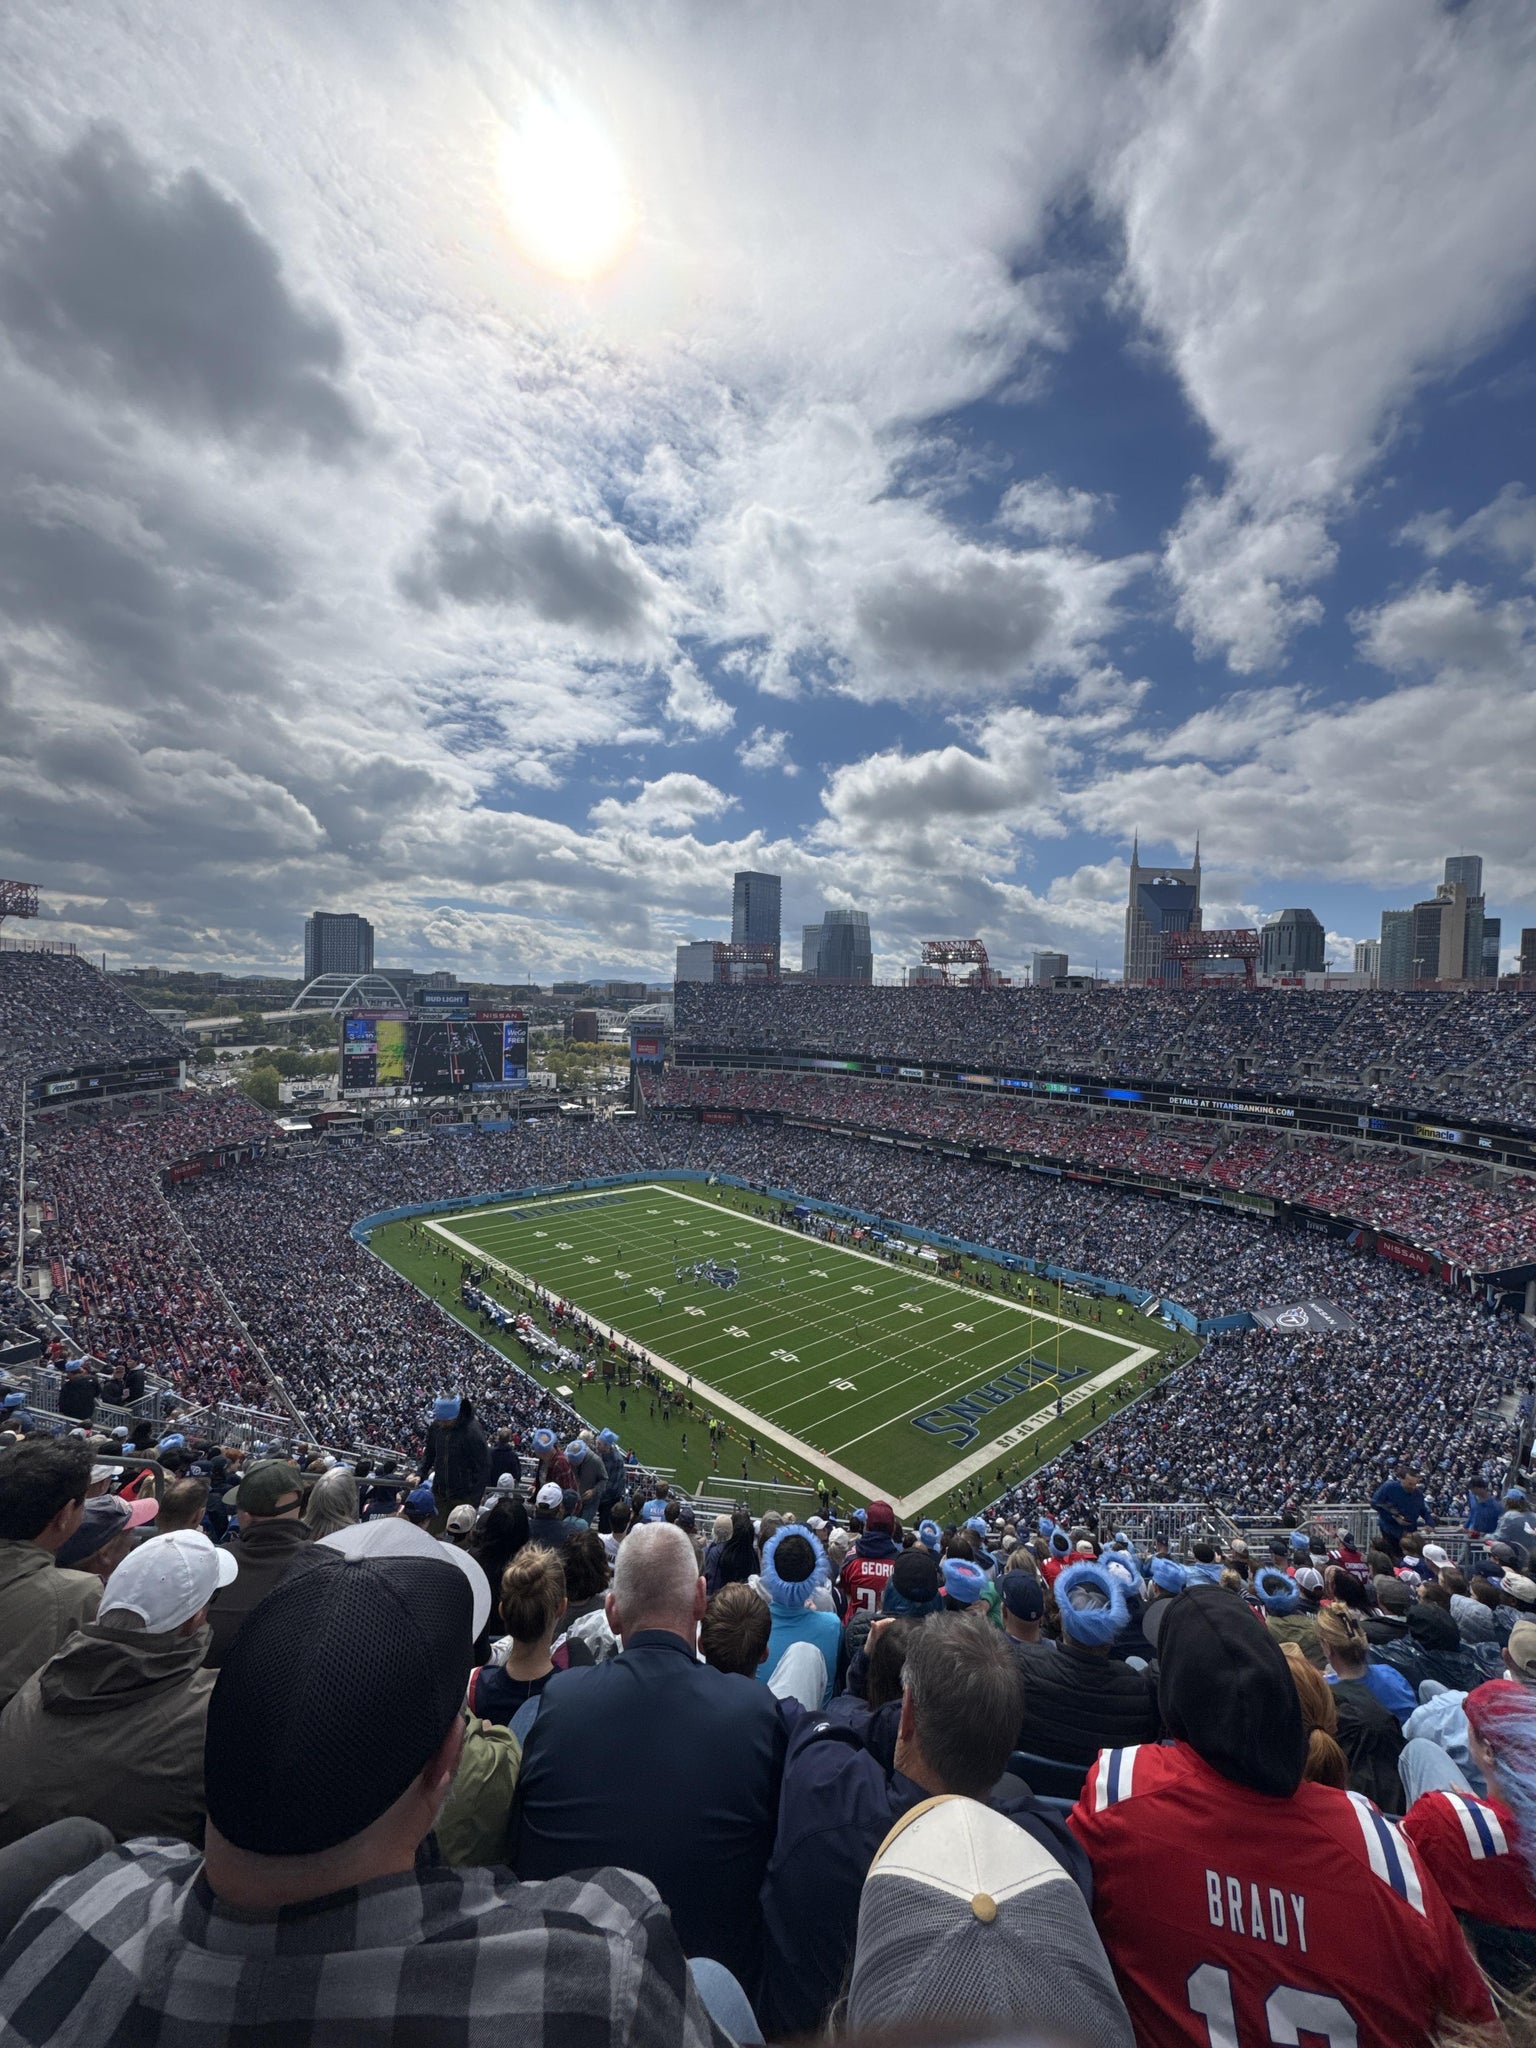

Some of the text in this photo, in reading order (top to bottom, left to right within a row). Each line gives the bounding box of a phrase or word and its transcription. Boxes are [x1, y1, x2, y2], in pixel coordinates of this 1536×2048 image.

[1169, 1096, 1295, 1117] DETAILS AT TITANSBANKING.COM
[1416, 1125, 1455, 1141] Pinnacle
[174, 1162, 200, 1175] NISSAN
[1383, 1242, 1424, 1263] NISSAN
[1308, 1302, 1338, 1326] NISSAN
[1030, 1409, 1056, 1424] ALL
[1016, 1424, 1034, 1436] OF
[995, 1435, 1018, 1448] US
[1205, 1868, 1308, 1953] BRADY
